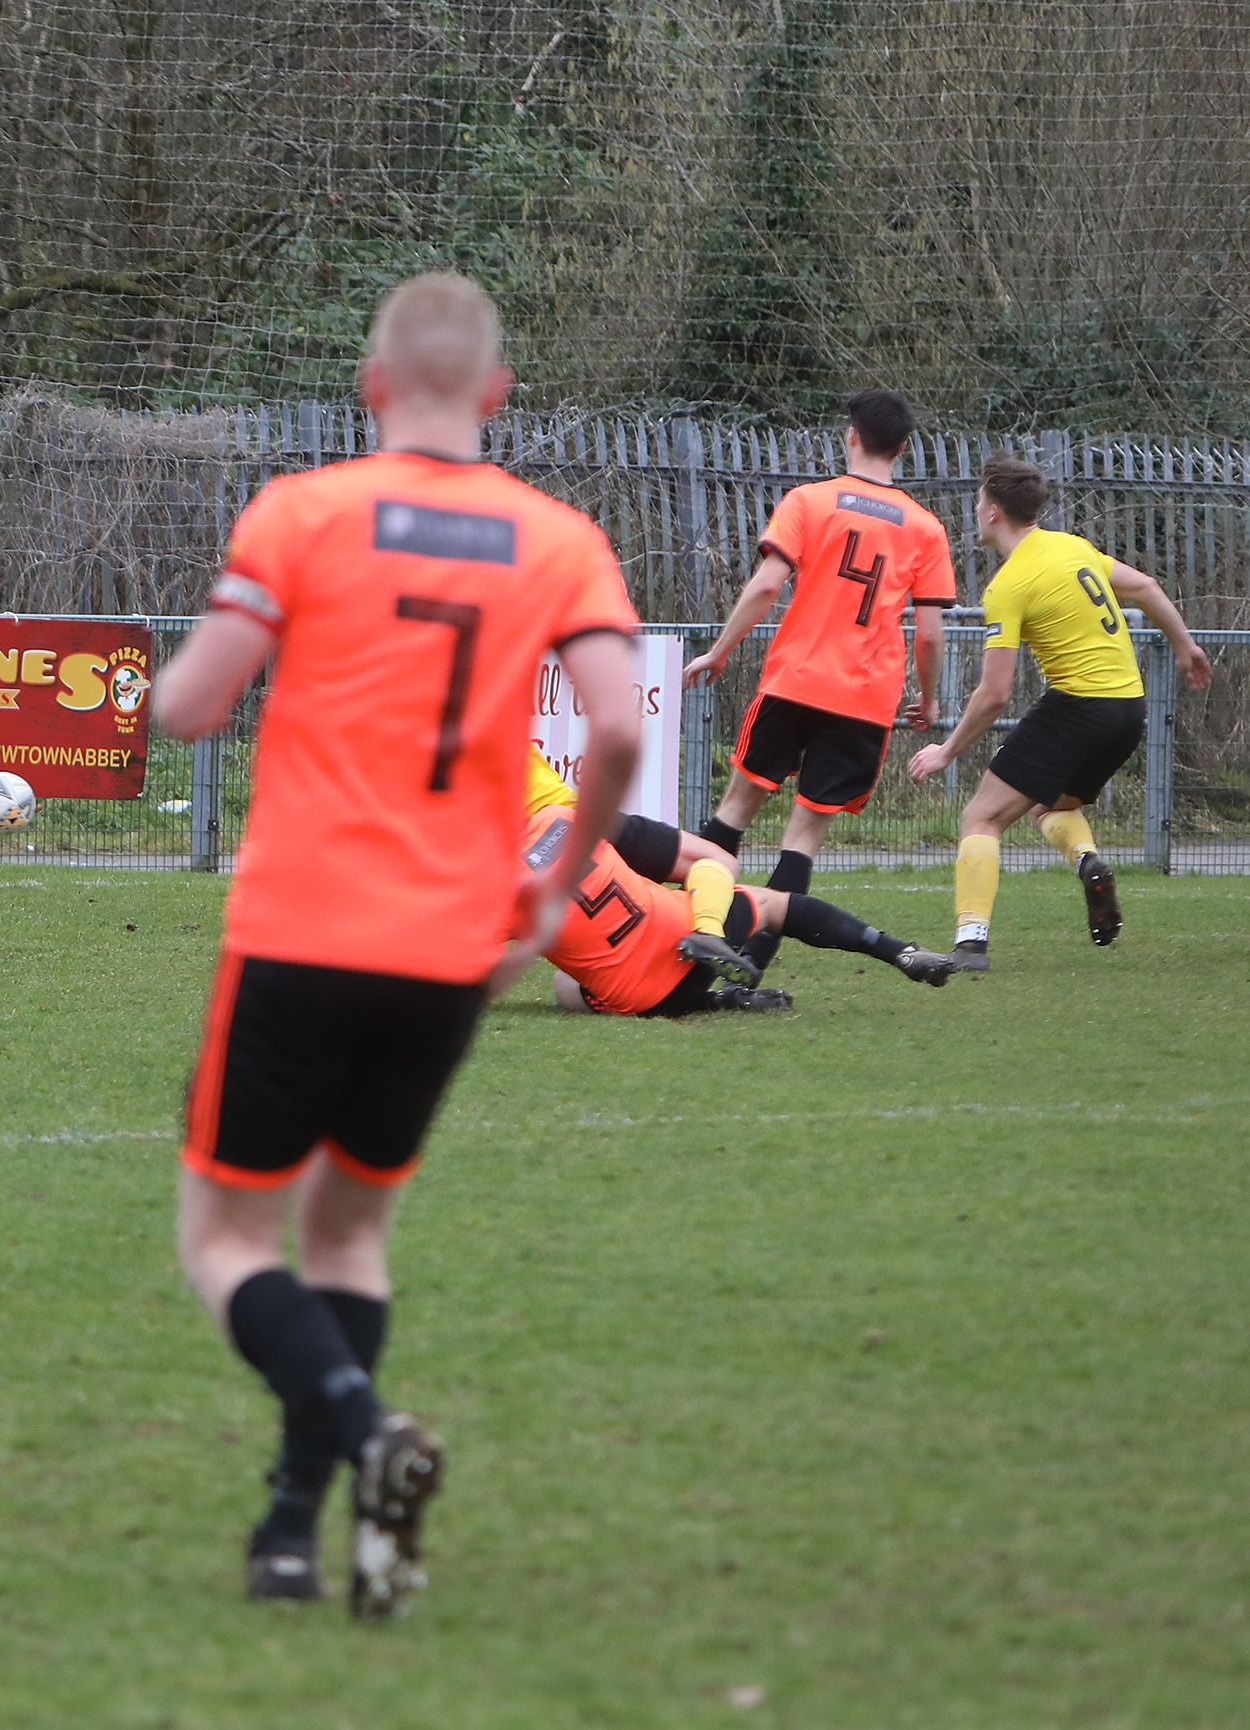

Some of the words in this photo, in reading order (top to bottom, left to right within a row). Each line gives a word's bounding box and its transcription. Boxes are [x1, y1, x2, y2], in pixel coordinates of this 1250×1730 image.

[837, 529, 887, 627] 4
[1077, 567, 1119, 635] 9
[109, 647, 147, 668] PIZZA
[395, 593, 482, 792] 7
[569, 860, 646, 949] 5
